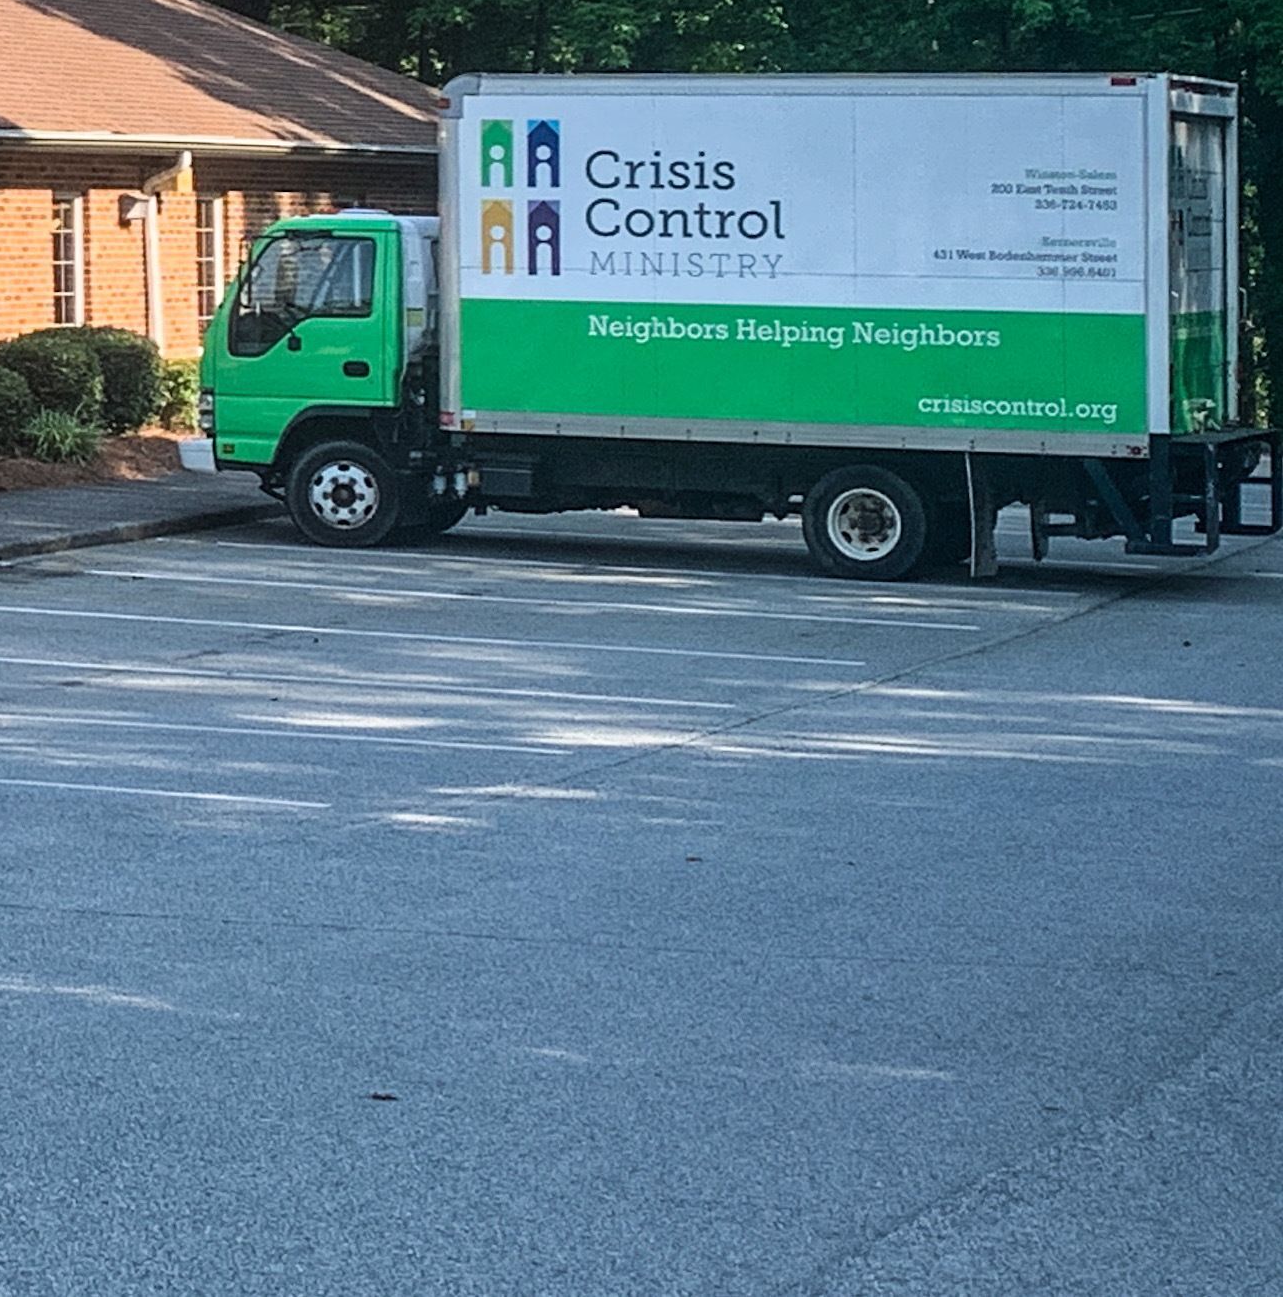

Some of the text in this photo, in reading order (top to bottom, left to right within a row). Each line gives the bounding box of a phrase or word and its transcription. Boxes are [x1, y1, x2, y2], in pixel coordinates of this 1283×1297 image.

[585, 149, 736, 191] Crisis
[1024, 168, 1117, 180] Winston-Salem
[1080, 184, 1118, 196] Street
[585, 197, 786, 241] Control
[589, 250, 784, 280] MINISTRY
[956, 249, 986, 261] West
[1080, 251, 1118, 263] Street
[587, 314, 1002, 353] Neighbors Helping Neighbors
[917, 393, 1119, 424] crisiscontrol.org
